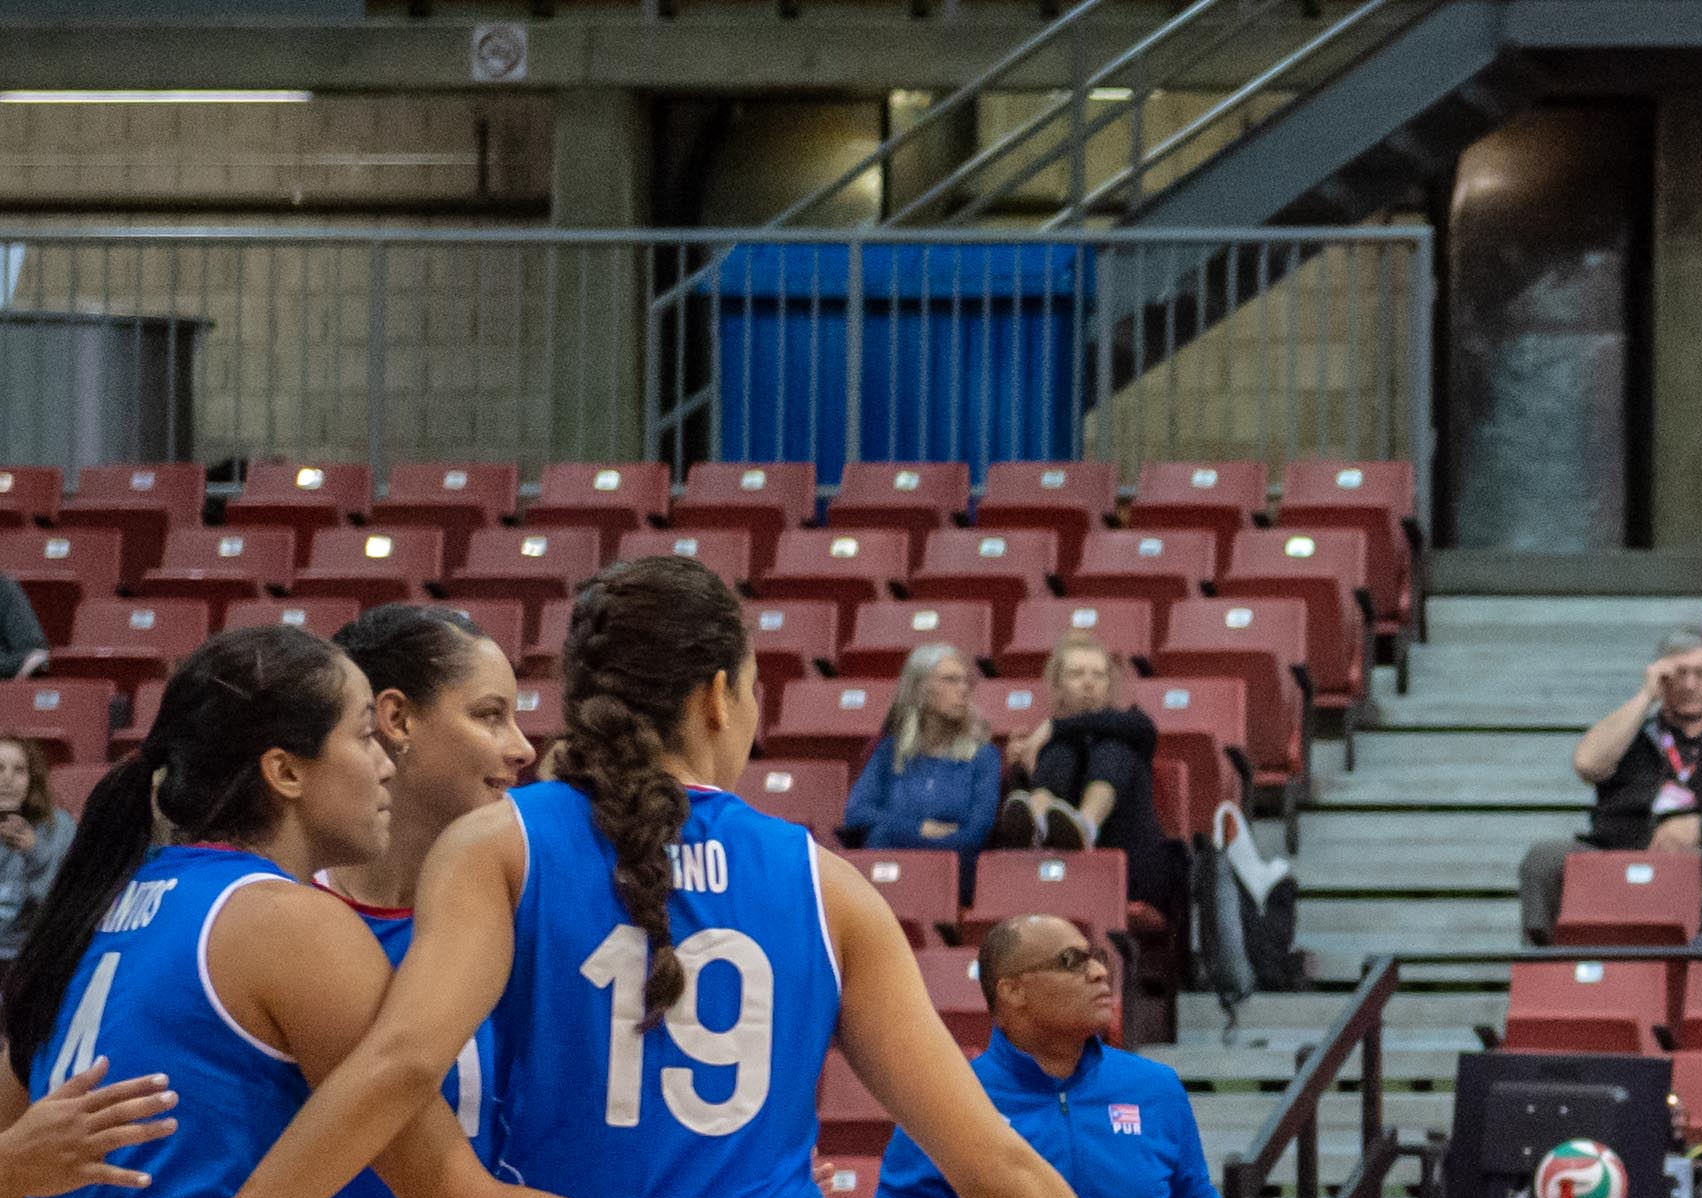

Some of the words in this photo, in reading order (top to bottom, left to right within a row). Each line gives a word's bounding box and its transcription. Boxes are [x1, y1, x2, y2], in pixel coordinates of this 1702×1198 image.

[48, 952, 121, 1095] 4
[580, 923, 774, 1136] 19
[1112, 1122, 1142, 1136] PUR
